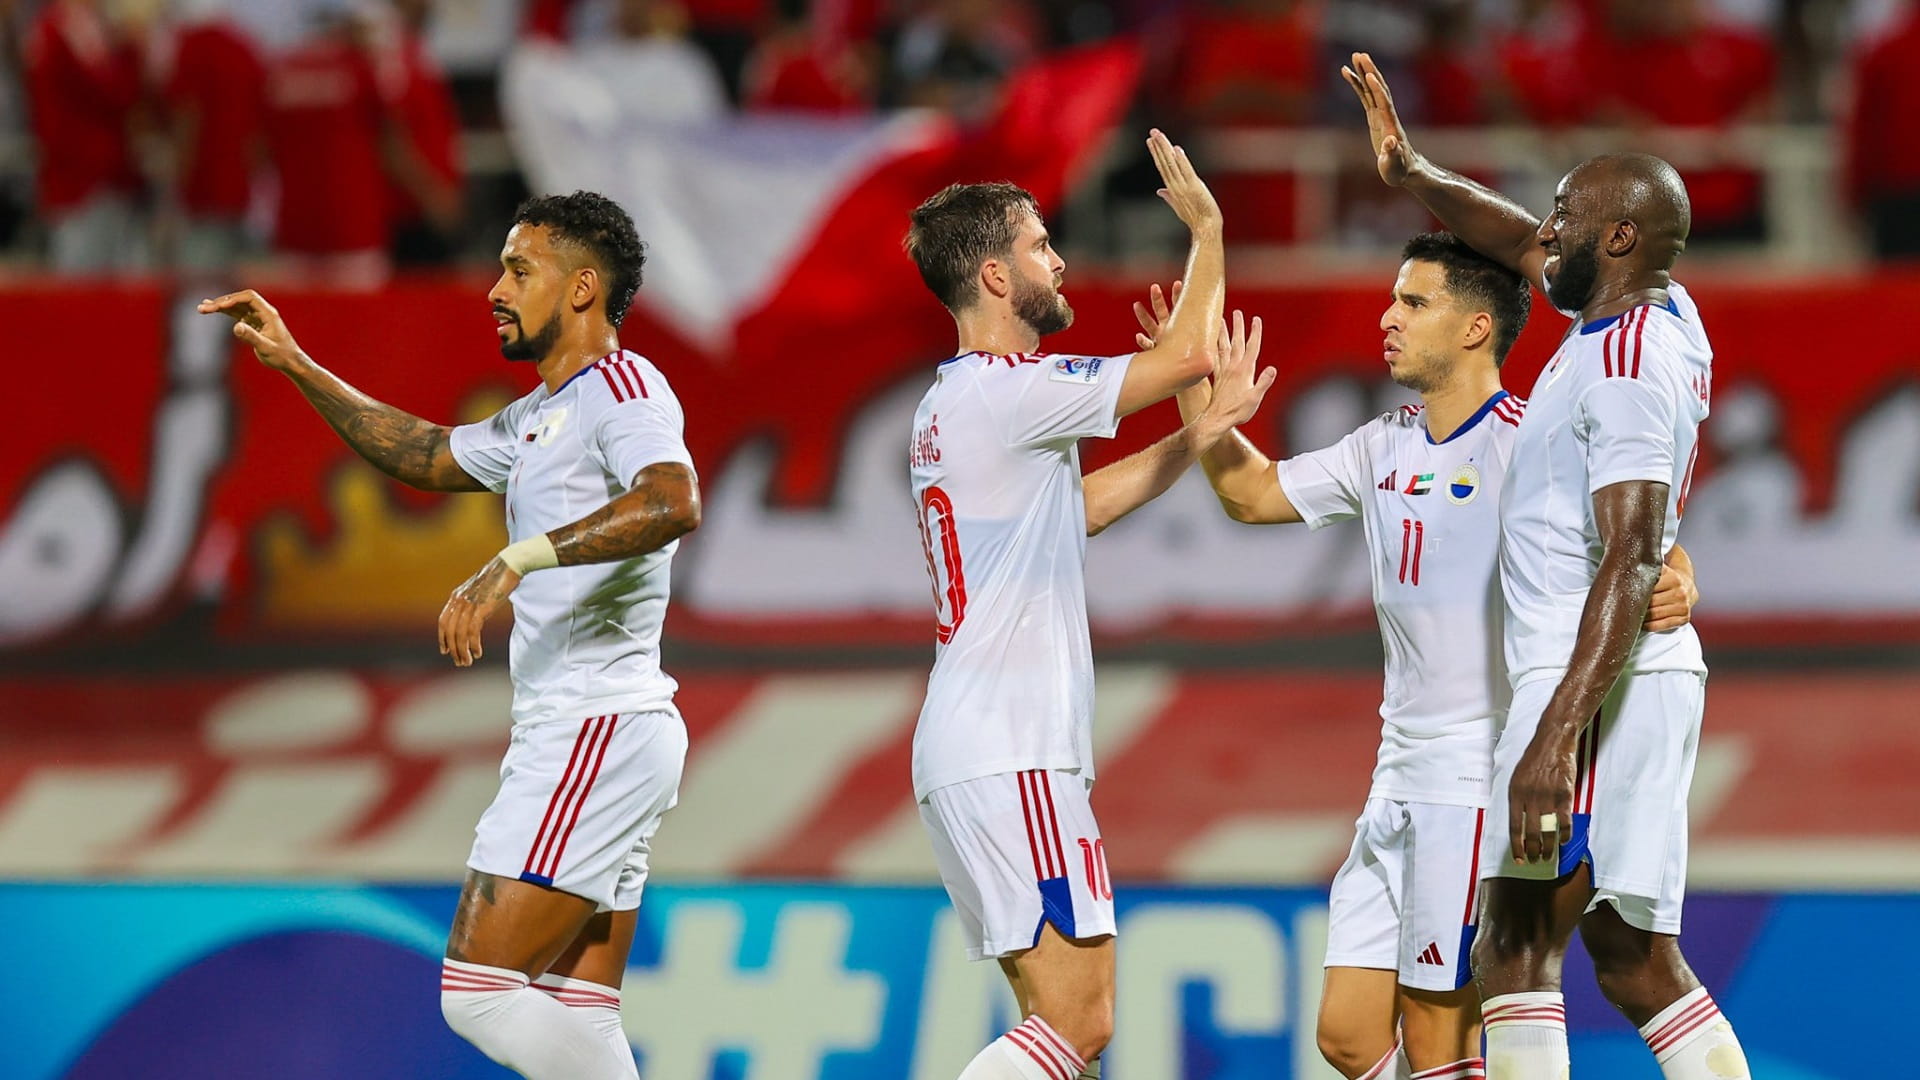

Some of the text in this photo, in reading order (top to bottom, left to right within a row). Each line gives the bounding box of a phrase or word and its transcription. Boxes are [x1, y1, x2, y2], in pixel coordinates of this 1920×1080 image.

[1399, 518, 1423, 586] 11
[1077, 837, 1112, 902] 10
[620, 902, 1362, 1080] #AC
